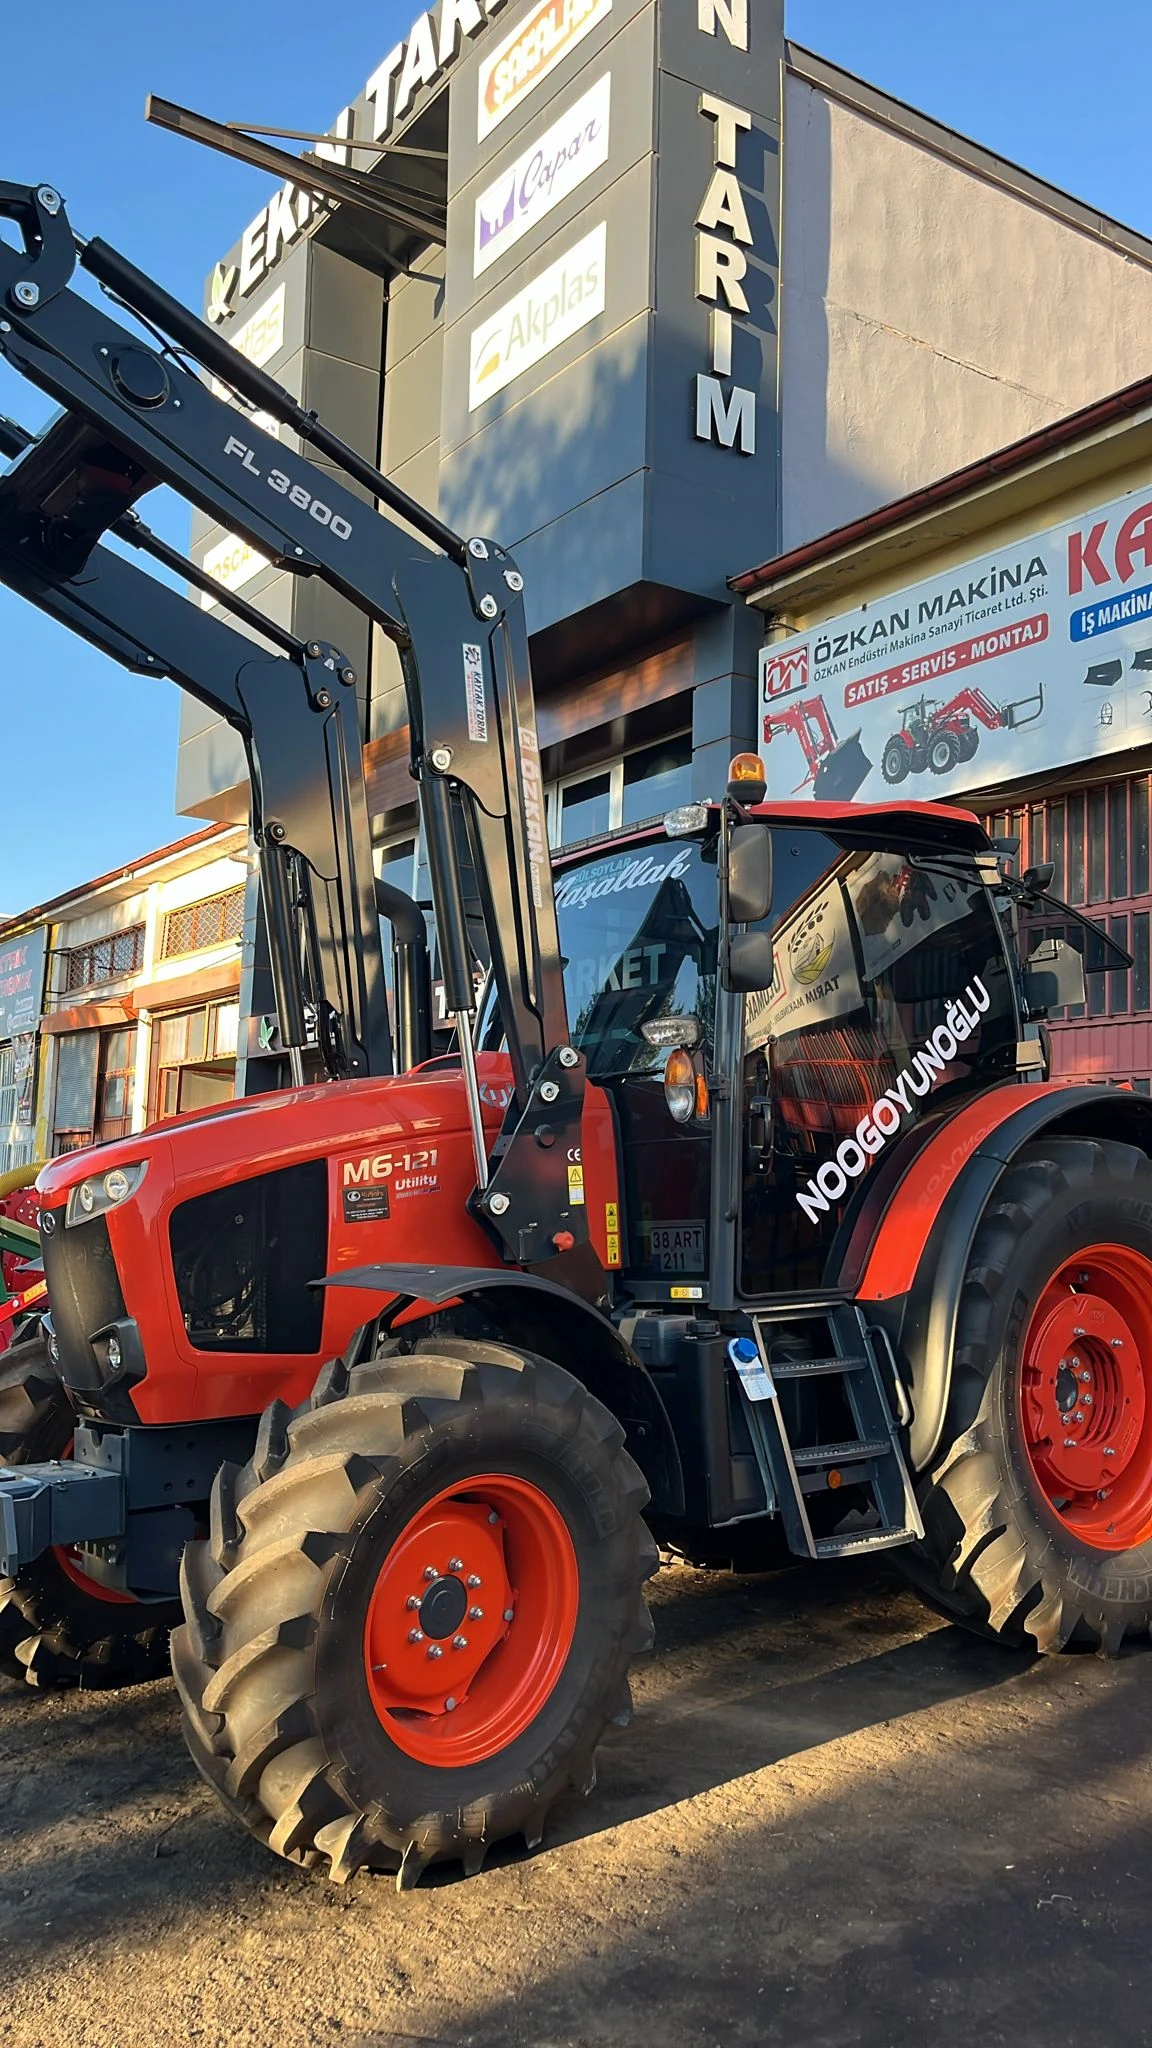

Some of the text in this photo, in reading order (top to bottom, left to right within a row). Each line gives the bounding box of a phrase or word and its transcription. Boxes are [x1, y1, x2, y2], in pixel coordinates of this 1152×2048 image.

[365, 0, 503, 145] TAR
[504, 260, 598, 361] Akplas
[694, 93, 757, 457] TARIM
[223, 435, 353, 541] FL 3800
[813, 556, 1049, 665] ÖZKAN MAKİNA
[813, 585, 1049, 683] ÖZKAN Endüstri Makina Sanayi Ticaret Ltd. Şti.
[1081, 611, 1095, 635] İŞ
[848, 674, 889, 703] SATIŞ
[901, 650, 957, 685] SERVİS
[970, 619, 1044, 660] MONTAJ
[476, 709, 486, 739] TORNA
[521, 756, 545, 865] ÖZKAN
[795, 975, 991, 1225] NOOGOYUNOĞLU
[343, 1149, 438, 1186] M6-121
[395, 1175, 438, 1191] Utility
[567, 1148, 581, 1162] CE
[653, 1230, 702, 1249] 38 ART
[663, 1252, 686, 1270] 211
